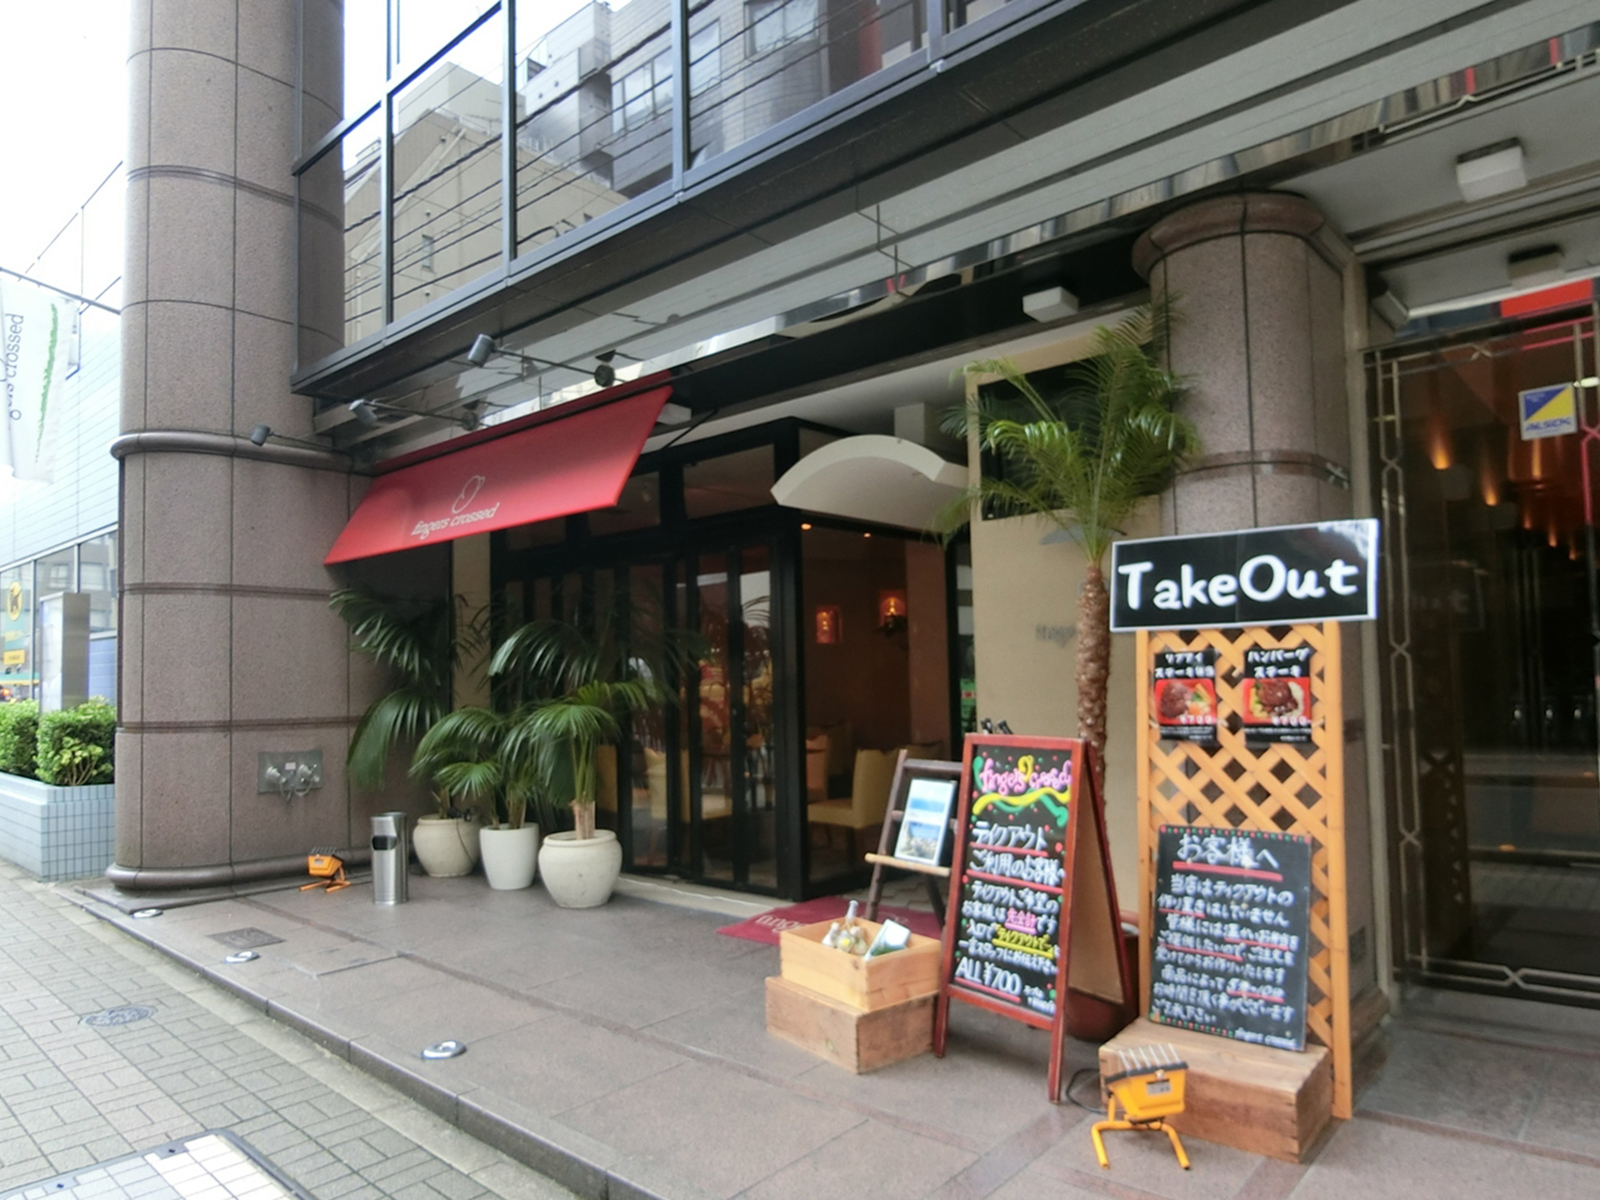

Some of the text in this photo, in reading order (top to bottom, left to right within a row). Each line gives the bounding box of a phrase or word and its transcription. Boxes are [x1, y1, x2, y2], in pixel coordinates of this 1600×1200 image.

[5, 313, 24, 378] crossed
[1247, 647, 1310, 663] ハンバーグ
[1253, 664, 1302, 678] ステーキ
[1177, 832, 1280, 869] お客様へ
[955, 956, 984, 985] ALL
[982, 961, 1022, 996] ¥700
